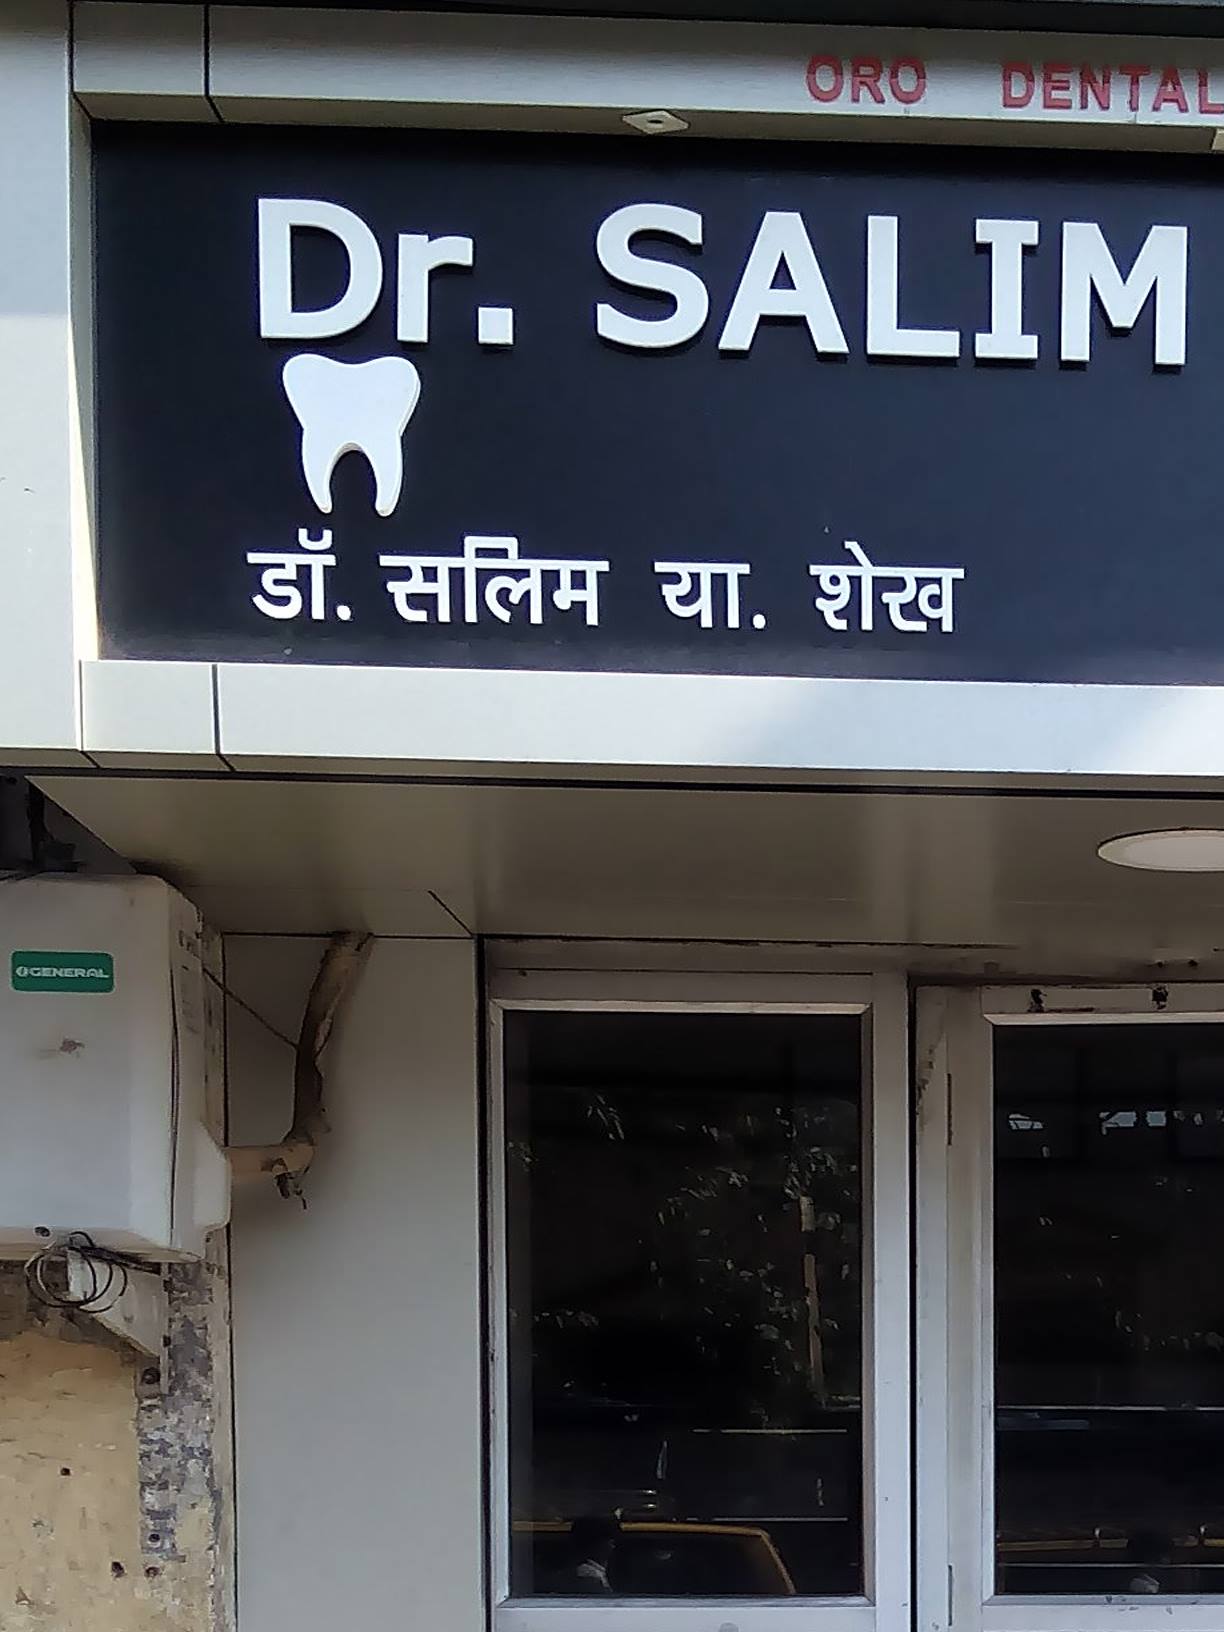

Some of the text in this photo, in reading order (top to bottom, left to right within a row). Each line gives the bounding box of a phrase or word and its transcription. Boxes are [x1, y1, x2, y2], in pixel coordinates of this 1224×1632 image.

[805, 54, 927, 106] ORO
[257, 197, 516, 348] Dr.
[595, 202, 1188, 368] SALIM
[246, 528, 966, 634] डॉ. सलिम या. शेख
